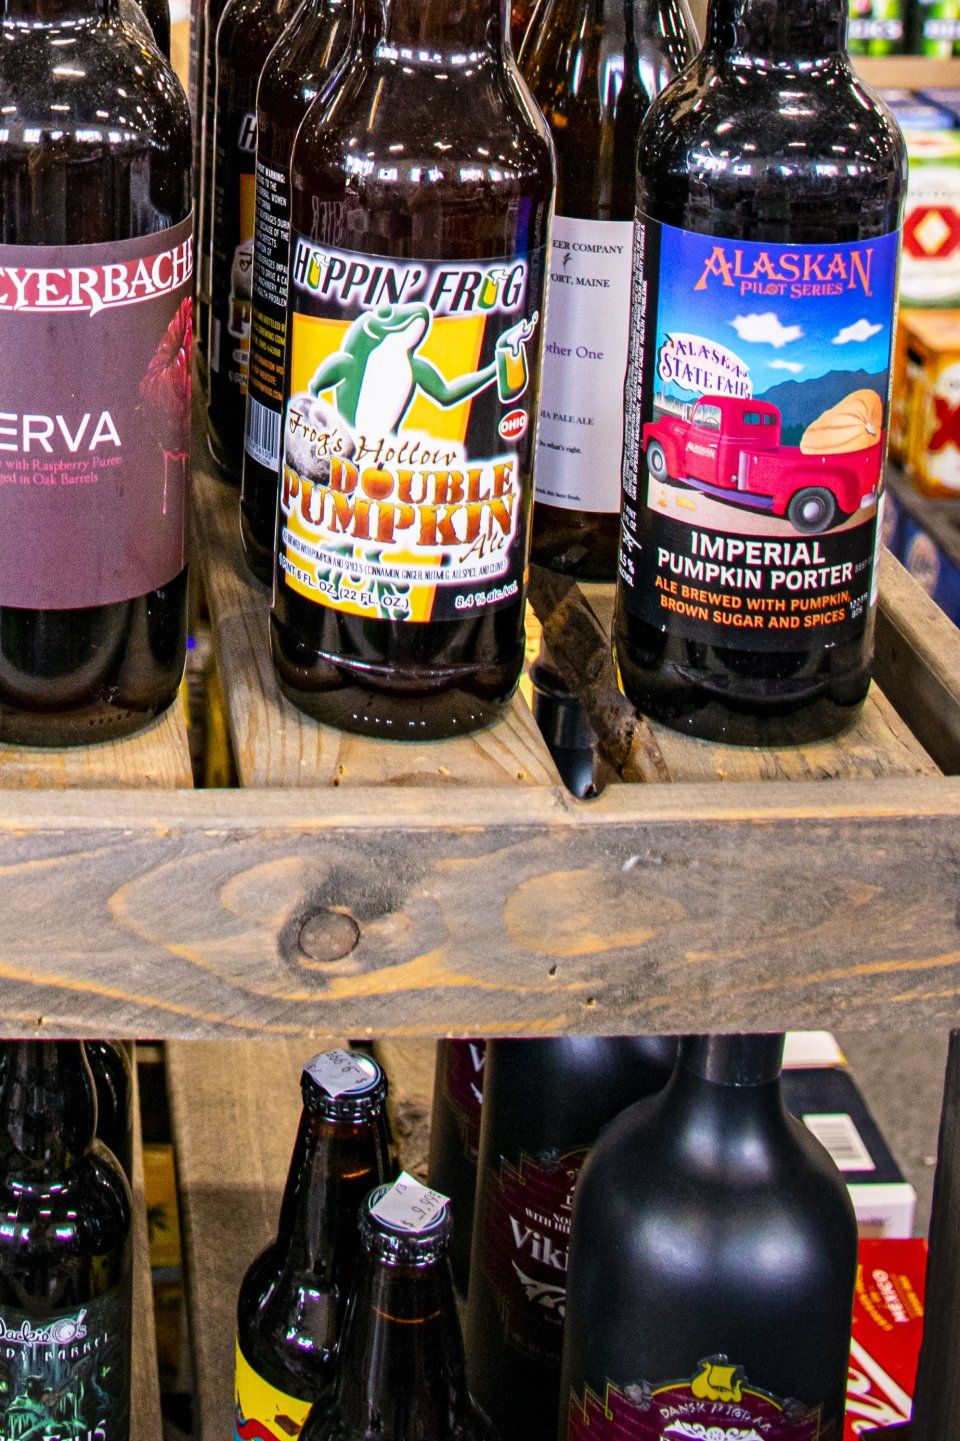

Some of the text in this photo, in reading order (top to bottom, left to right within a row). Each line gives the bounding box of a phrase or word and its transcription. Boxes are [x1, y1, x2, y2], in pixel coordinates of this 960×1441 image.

[552, 239, 625, 254] EER COMPANY
[429, 263, 526, 312] FROG
[575, 276, 611, 289] MAINE
[693, 246, 874, 298] ALASKAN
[740, 280, 844, 299] PILOT SERIES
[575, 345, 604, 361] One
[675, 339, 748, 378] ALASKA
[662, 352, 752, 400] STATE FAIR
[500, 415, 528, 433] OHIO
[553, 411, 576, 424] PALE
[576, 416, 595, 426] ALE
[289, 408, 457, 466] Frog's Hollow
[6, 458, 29, 472] with
[32, 457, 90, 473] Raspberry
[33, 472, 57, 485] Oak
[60, 471, 99, 486] Barrels
[329, 456, 515, 505] DOUBLE
[282, 464, 516, 547] PUMPKIN
[459, 531, 505, 564] Ale
[690, 530, 827, 567] IMPERIAL
[657, 546, 763, 591] PUMPKIN
[770, 560, 853, 591] PORTER
[303, 572, 317, 589] FL.
[339, 585, 357, 601] (22
[360, 591, 380, 606] FL.
[382, 595, 411, 610] OZ.)
[455, 594, 474, 609] 8.4
[654, 574, 678, 596] ALE
[680, 584, 742, 610] BREWED
[745, 596, 787, 612] WITH
[790, 590, 852, 611] PUMPKIN,
[660, 593, 846, 630] BROWN SUGAR AND SPICES
[525, 1206, 552, 1228] WITH
[659, 1402, 706, 1419] DANSK
